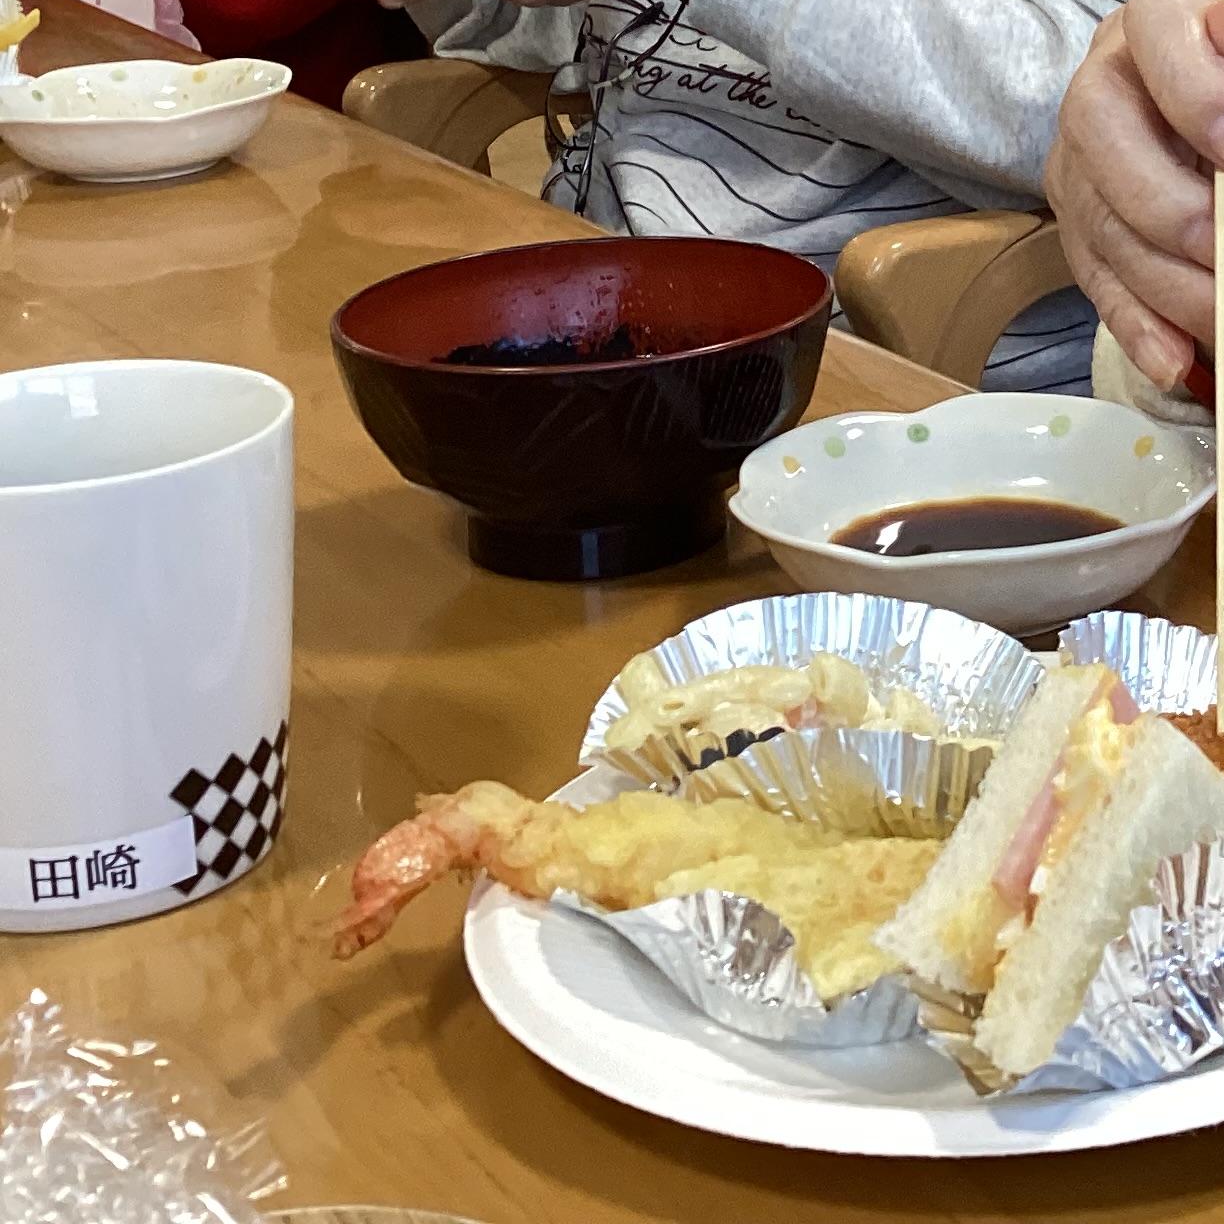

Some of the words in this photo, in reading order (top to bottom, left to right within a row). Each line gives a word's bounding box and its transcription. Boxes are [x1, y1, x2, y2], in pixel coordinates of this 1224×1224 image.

[678, 63, 727, 93] at
[727, 71, 777, 109] the
[29, 844, 140, 902] 田崎
